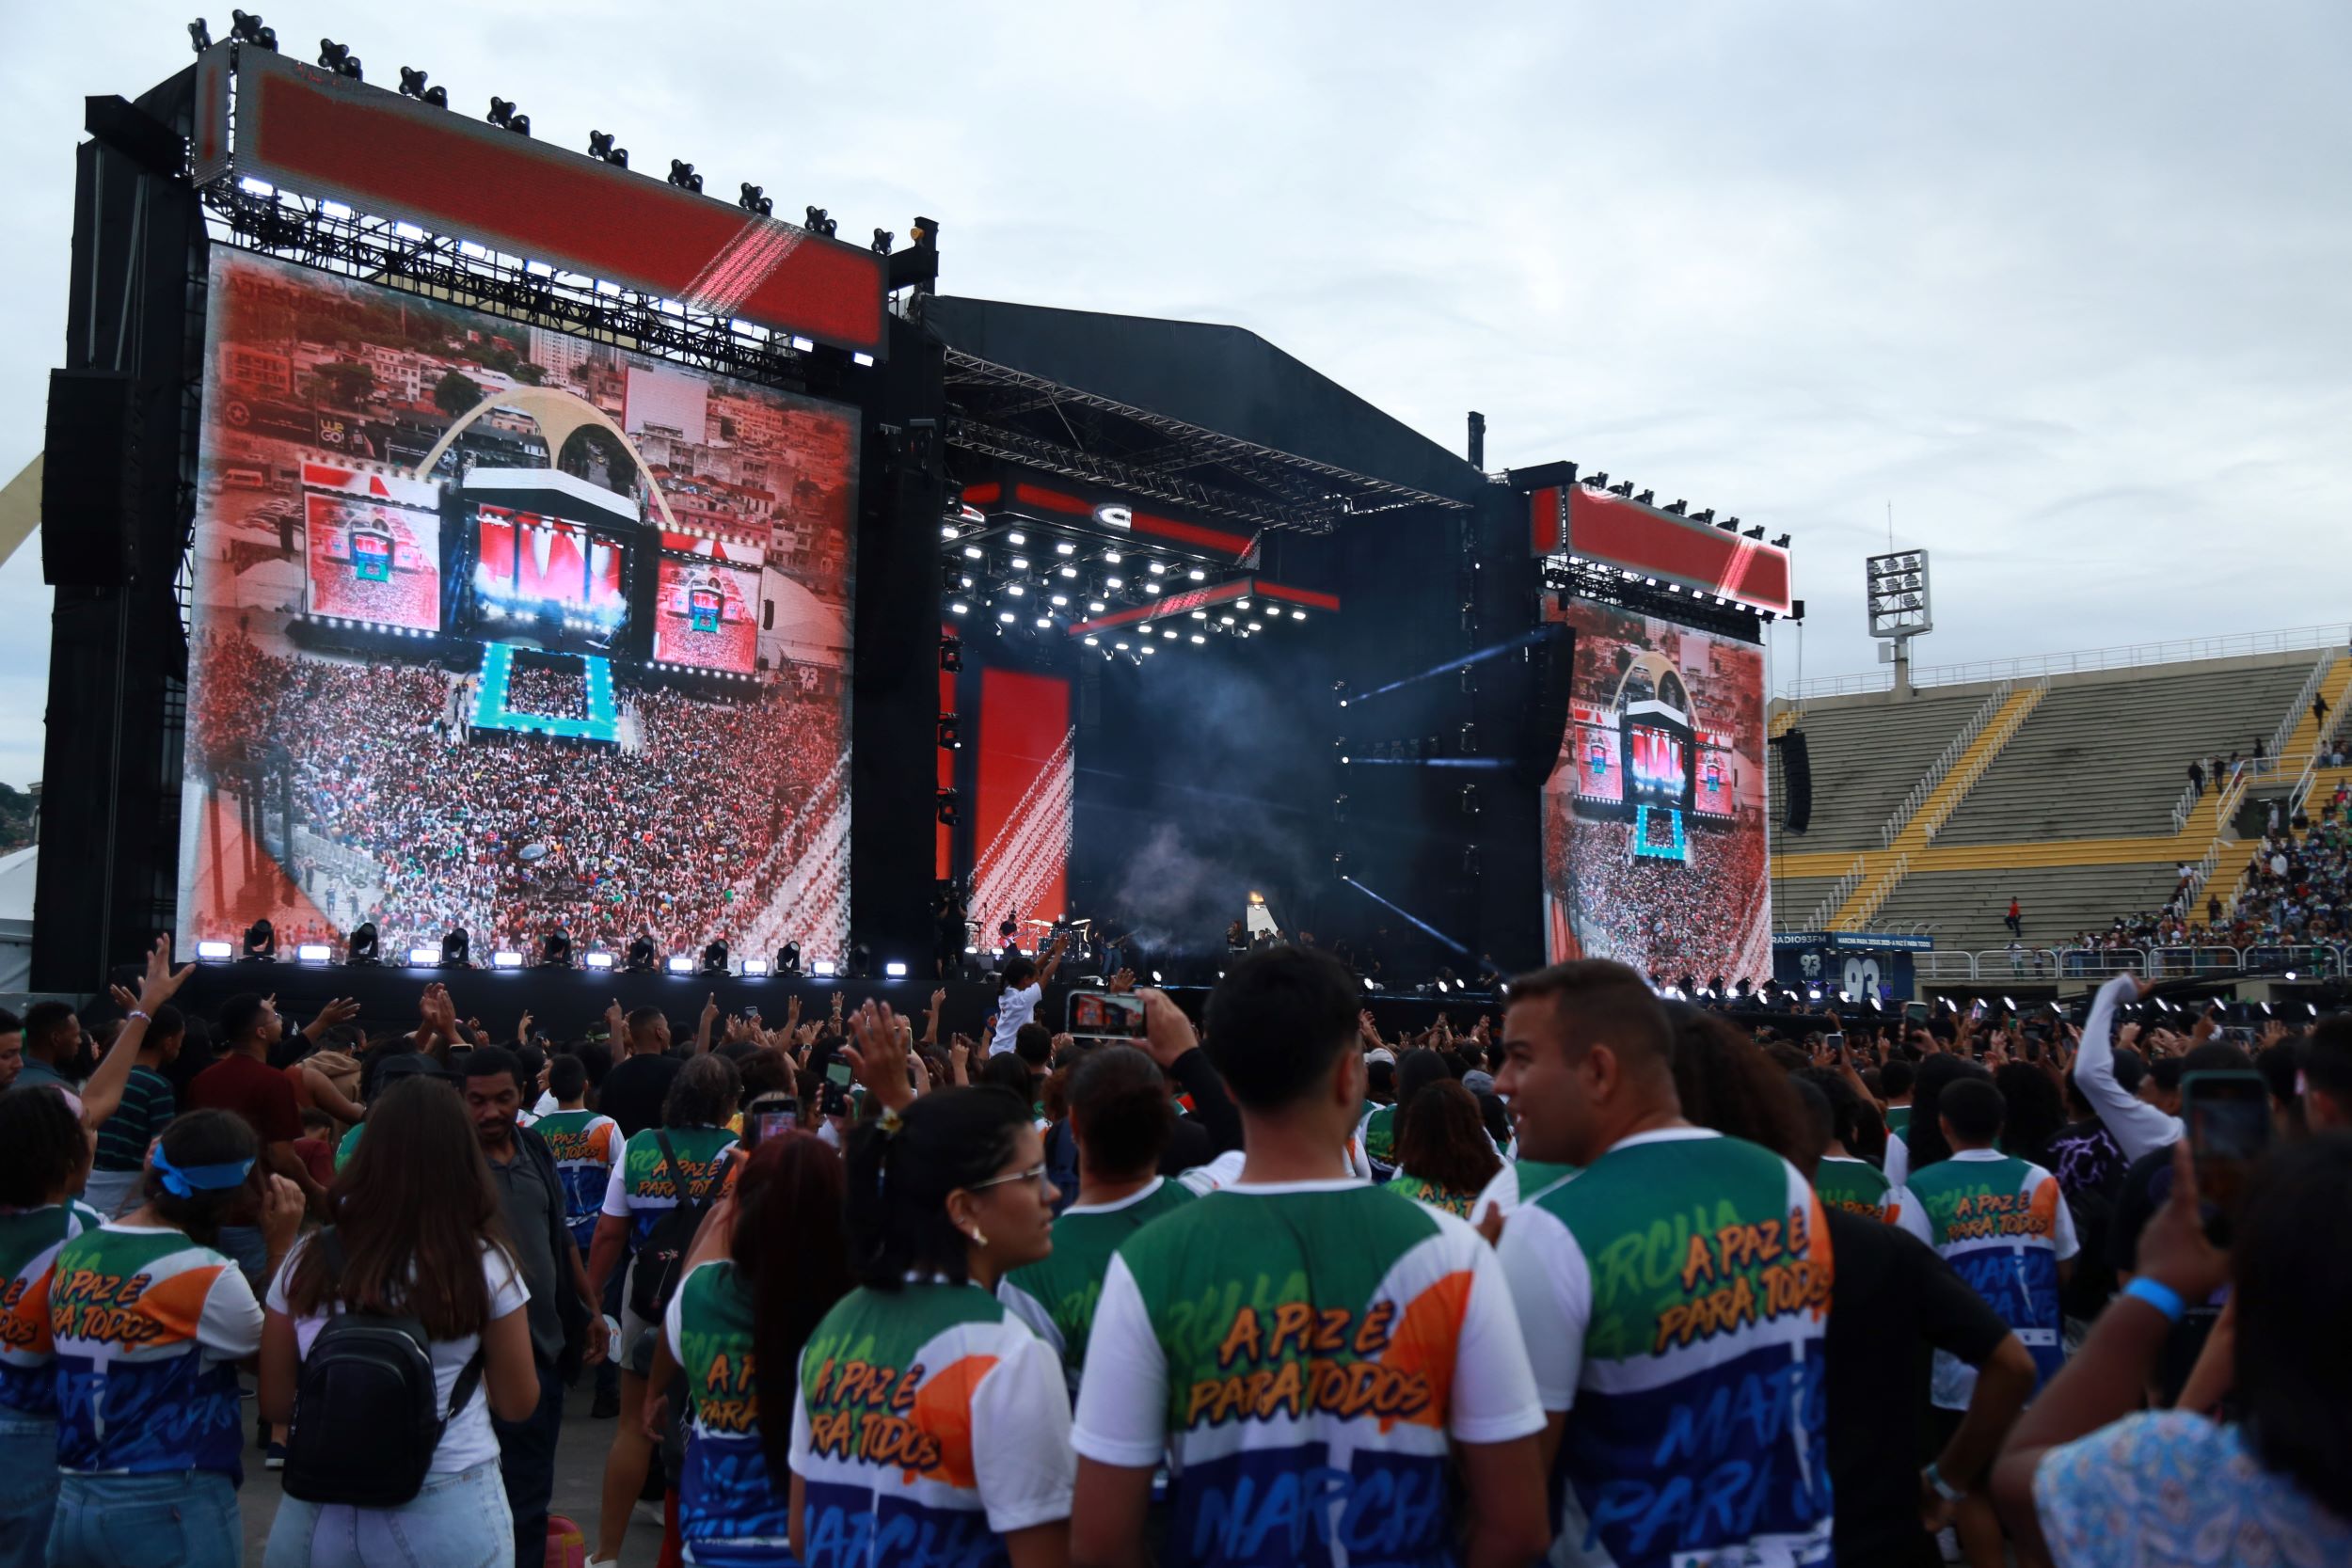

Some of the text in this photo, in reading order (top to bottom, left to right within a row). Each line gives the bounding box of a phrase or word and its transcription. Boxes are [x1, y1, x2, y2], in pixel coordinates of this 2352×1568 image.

[1800, 955, 1821, 971] 93
[1844, 958, 1882, 1005] 93
[651, 1158, 670, 1178] A
[1947, 1212, 2049, 1243] PARA TODOS
[1955, 1196, 1973, 1221] A
[1976, 1193, 2016, 1216] PAZ
[1681, 1232, 1716, 1293] A
[1716, 1216, 1785, 1279] PAZ
[64, 1268, 121, 1304] PAZ
[1652, 1274, 1757, 1358] PARA
[1219, 1306, 1265, 1370] A
[707, 1354, 731, 1394] A
[832, 1358, 898, 1411] PAZ
[1185, 1355, 1432, 1435] PARA TODOS
